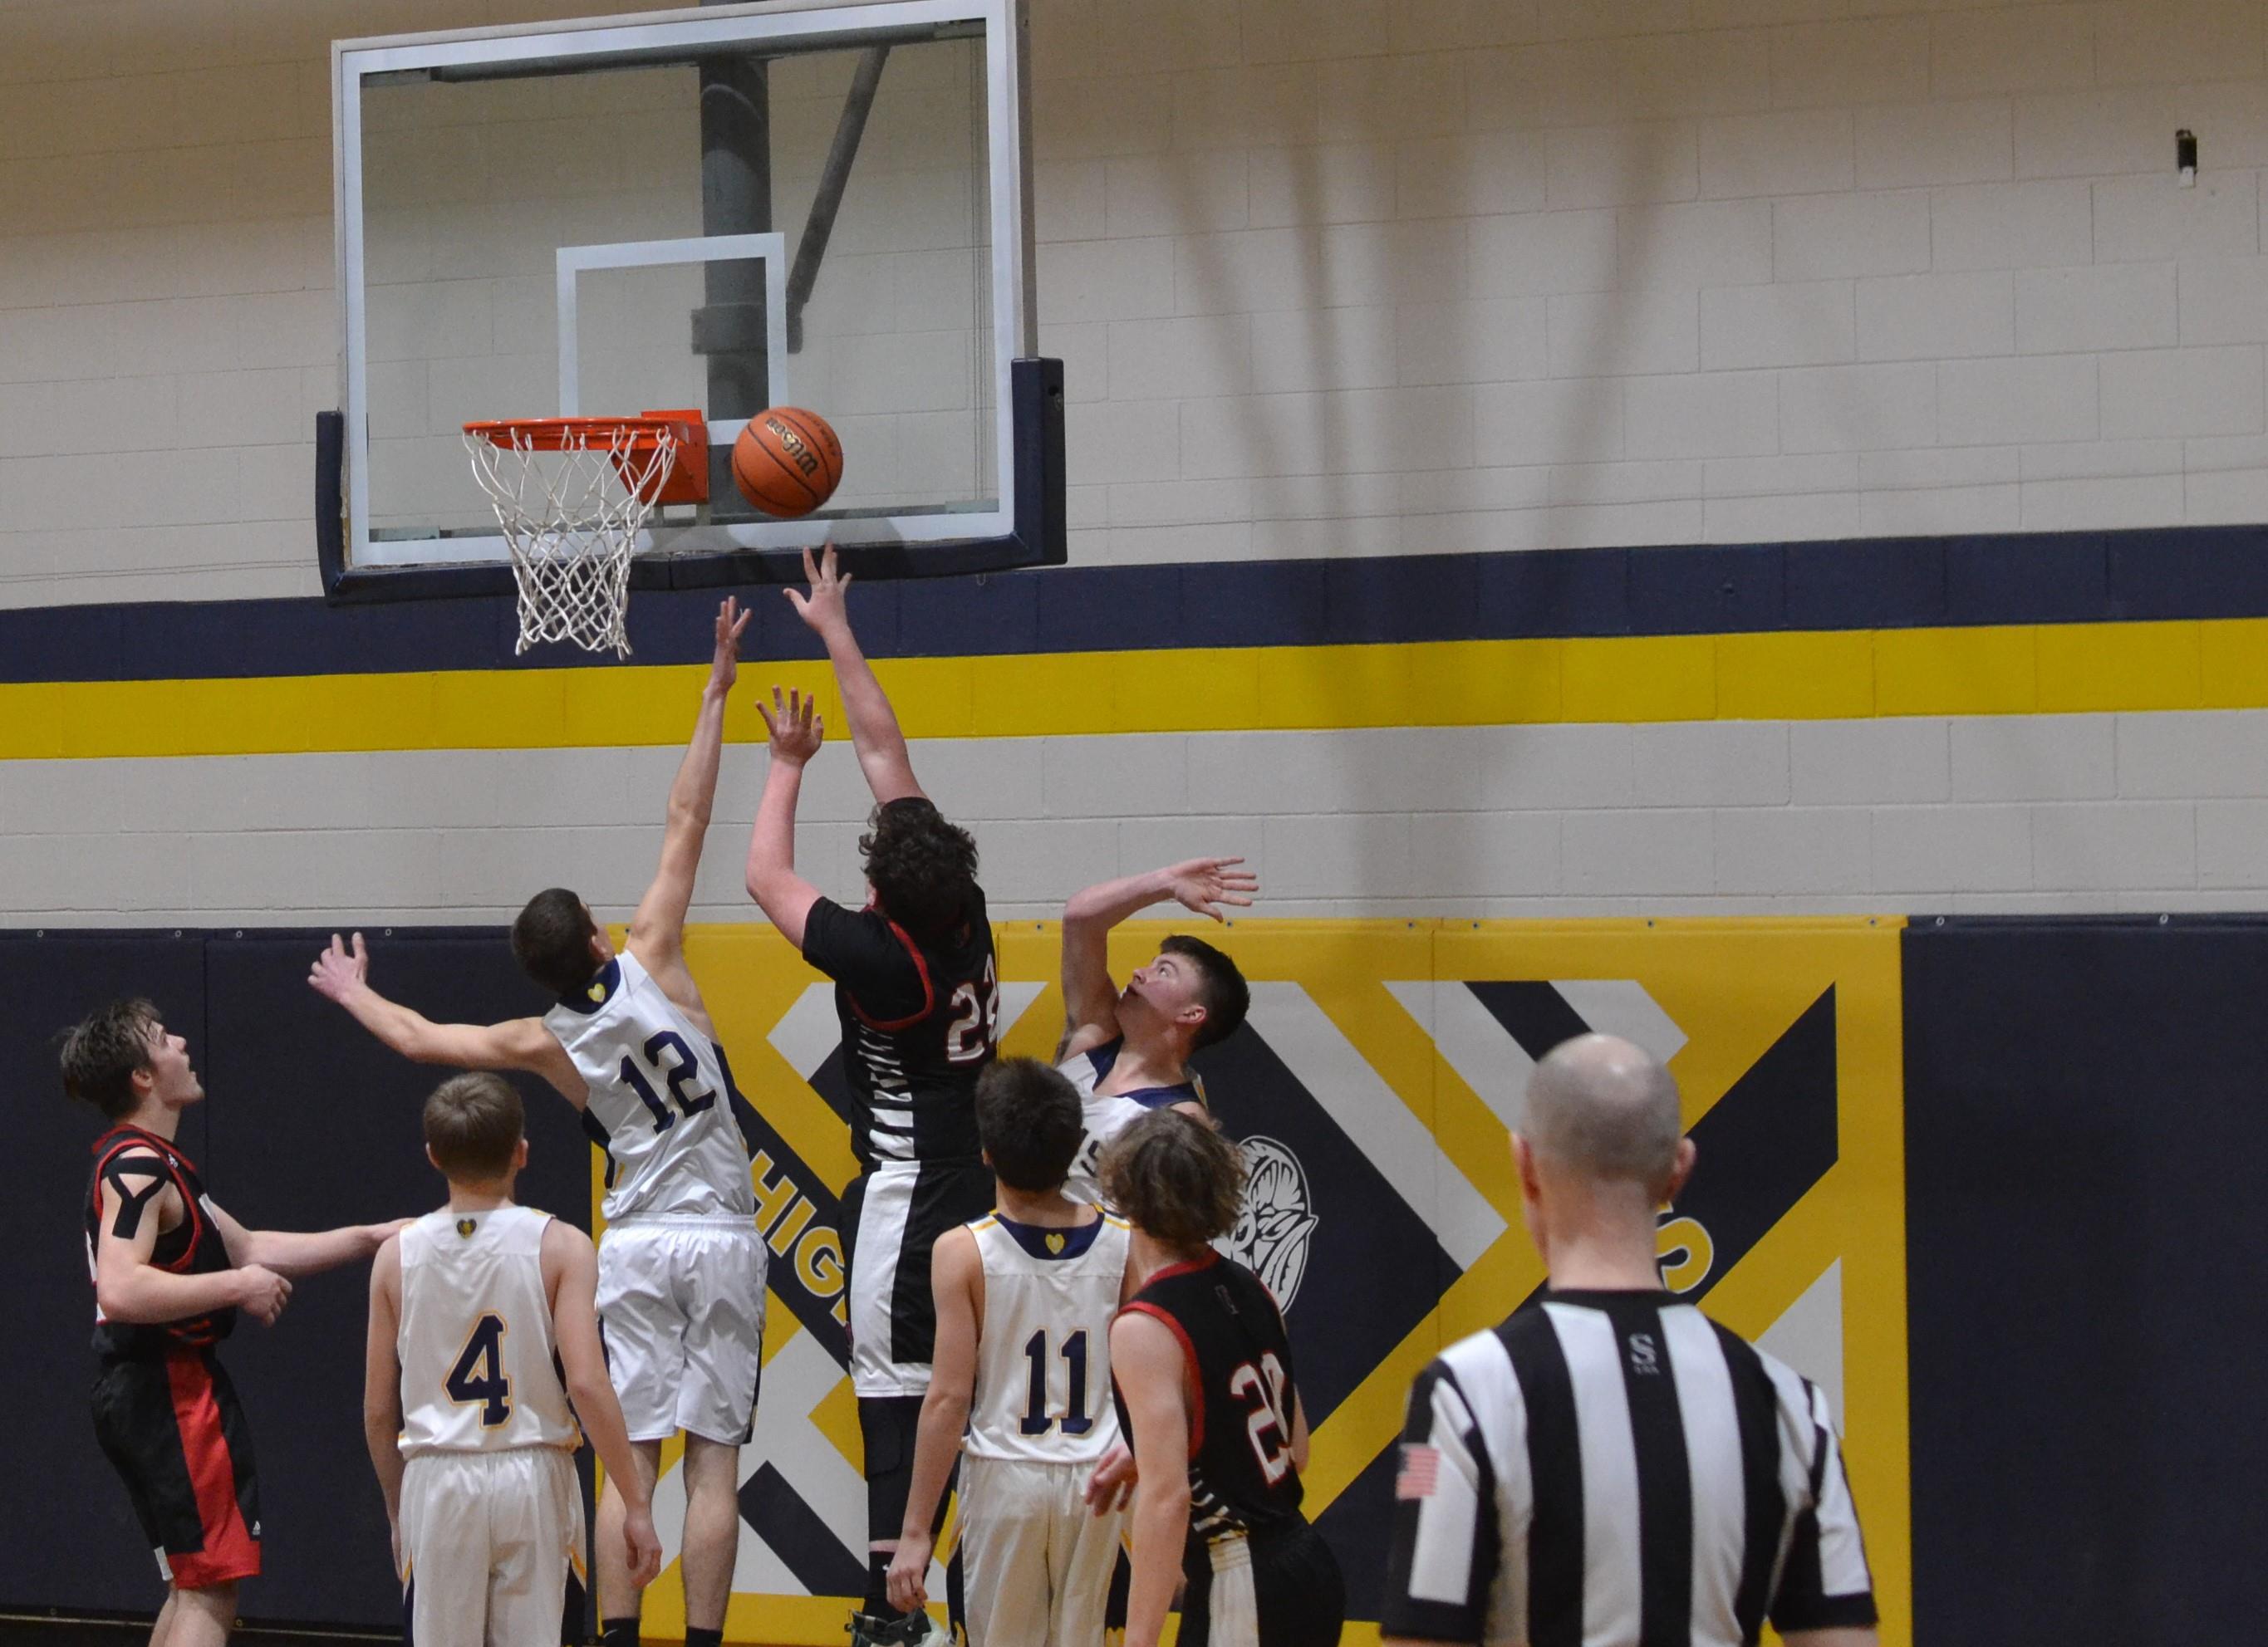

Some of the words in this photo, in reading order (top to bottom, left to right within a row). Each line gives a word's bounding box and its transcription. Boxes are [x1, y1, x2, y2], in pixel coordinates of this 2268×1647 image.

[764, 416, 819, 478] Wilson
[618, 1028, 717, 1135] 12
[750, 1148, 848, 1327] HIG
[442, 1311, 513, 1430] 4
[1019, 1327, 1094, 1438] 11
